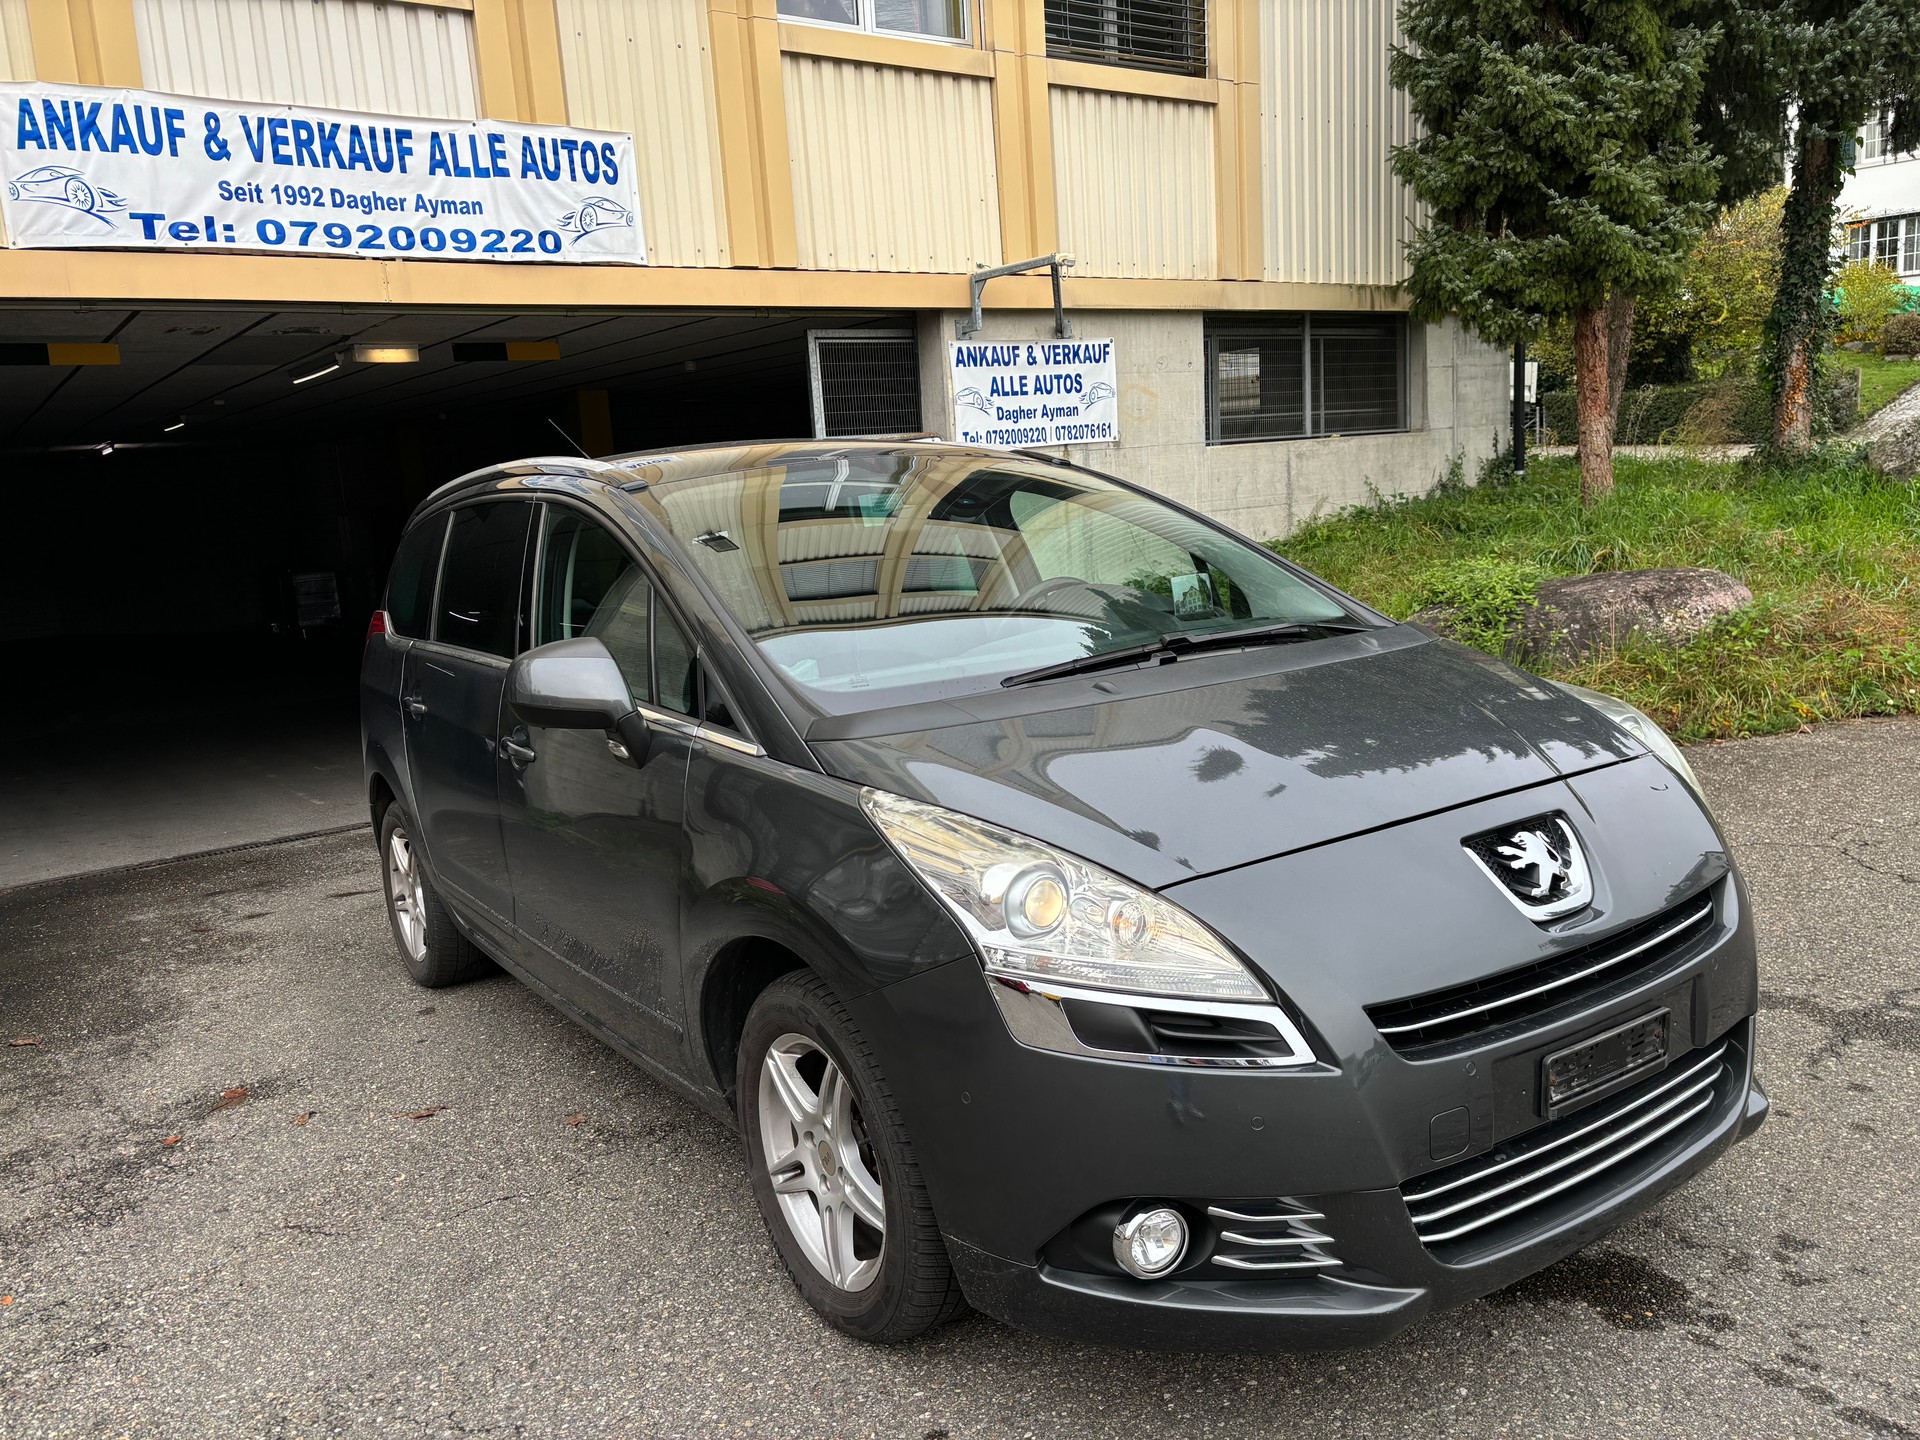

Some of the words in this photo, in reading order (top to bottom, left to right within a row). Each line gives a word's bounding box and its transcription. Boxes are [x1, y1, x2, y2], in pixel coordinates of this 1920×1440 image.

[17, 98, 185, 157] ANKAUF
[204, 112, 231, 161] &
[240, 115, 413, 174] VERKAUF
[429, 132, 510, 178] ALLE
[521, 136, 618, 185] AUTOS
[218, 180, 263, 204] Seit
[271, 185, 325, 207] 1992
[330, 188, 406, 215] Dagher
[415, 194, 483, 218] Ayman
[129, 212, 236, 243] Tel:
[256, 219, 562, 254] 0792009220
[956, 345, 1020, 368] ANKAUF
[1026, 345, 1038, 366] &
[1041, 343, 1111, 366] VERKAUF
[990, 375, 1029, 398] ALLE
[1034, 373, 1083, 396] AUTOS
[996, 406, 1038, 424] Dagher
[1041, 404, 1079, 422] Ayman
[985, 427, 1047, 445] 0792009220
[1055, 422, 1112, 441] 0782076161
